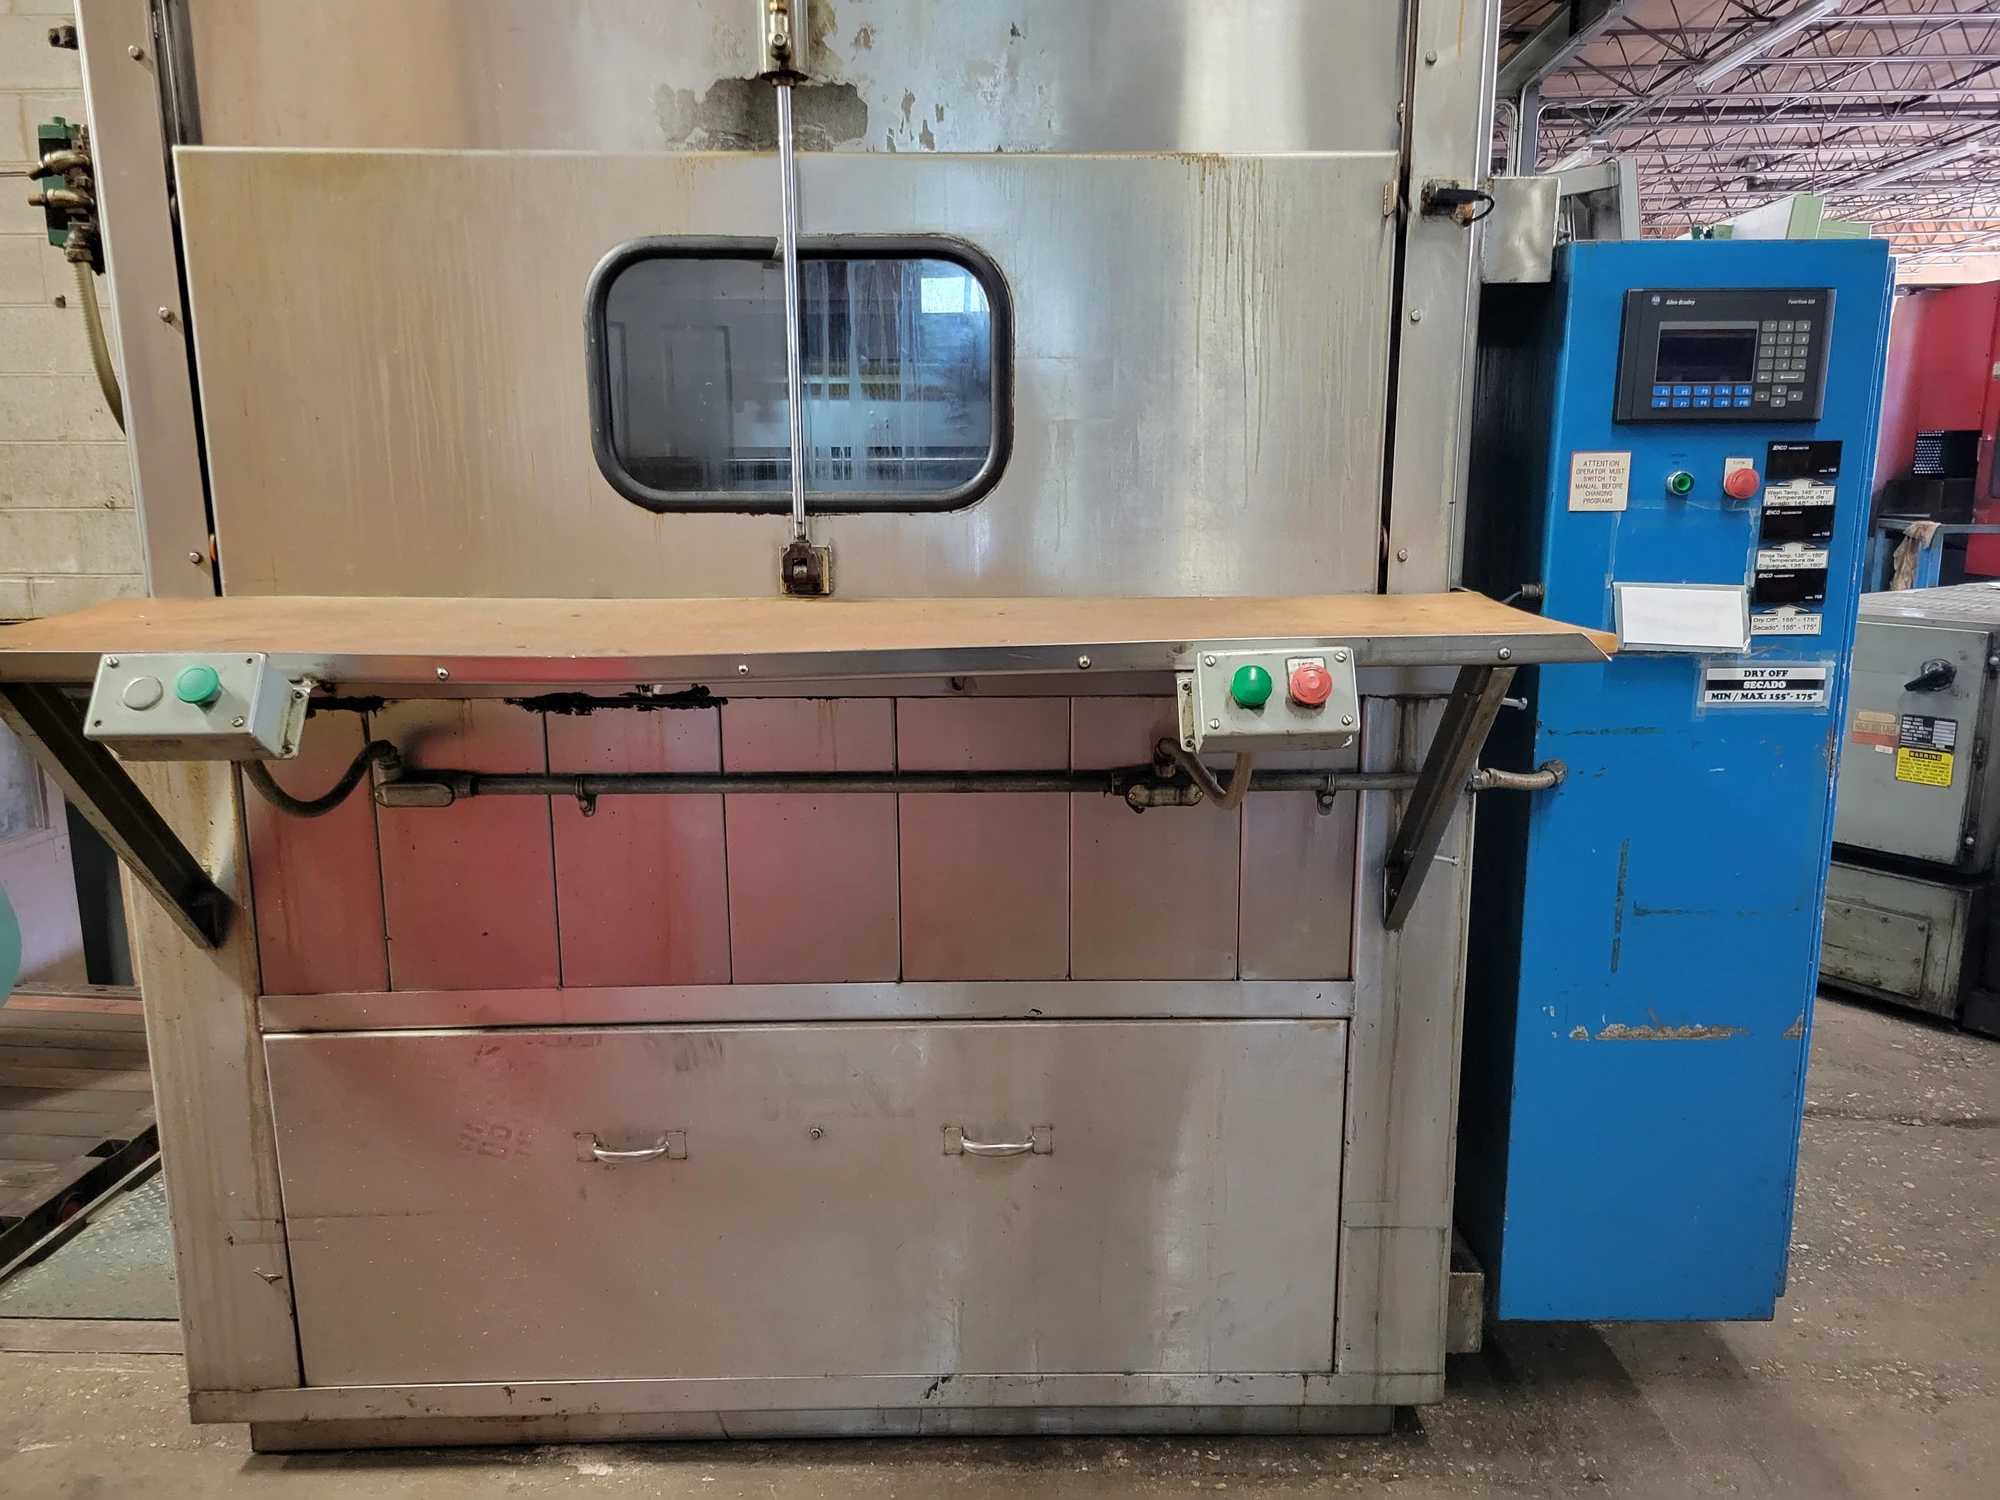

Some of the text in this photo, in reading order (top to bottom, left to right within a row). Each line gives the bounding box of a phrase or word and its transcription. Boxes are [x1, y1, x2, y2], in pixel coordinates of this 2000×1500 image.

[1768, 669, 1789, 677] OFF
[1743, 680, 1787, 689] SECADO
[1711, 692, 1732, 700] MIN
[1740, 692, 1767, 701] MAX:
[1910, 752, 1941, 760] WARNING
